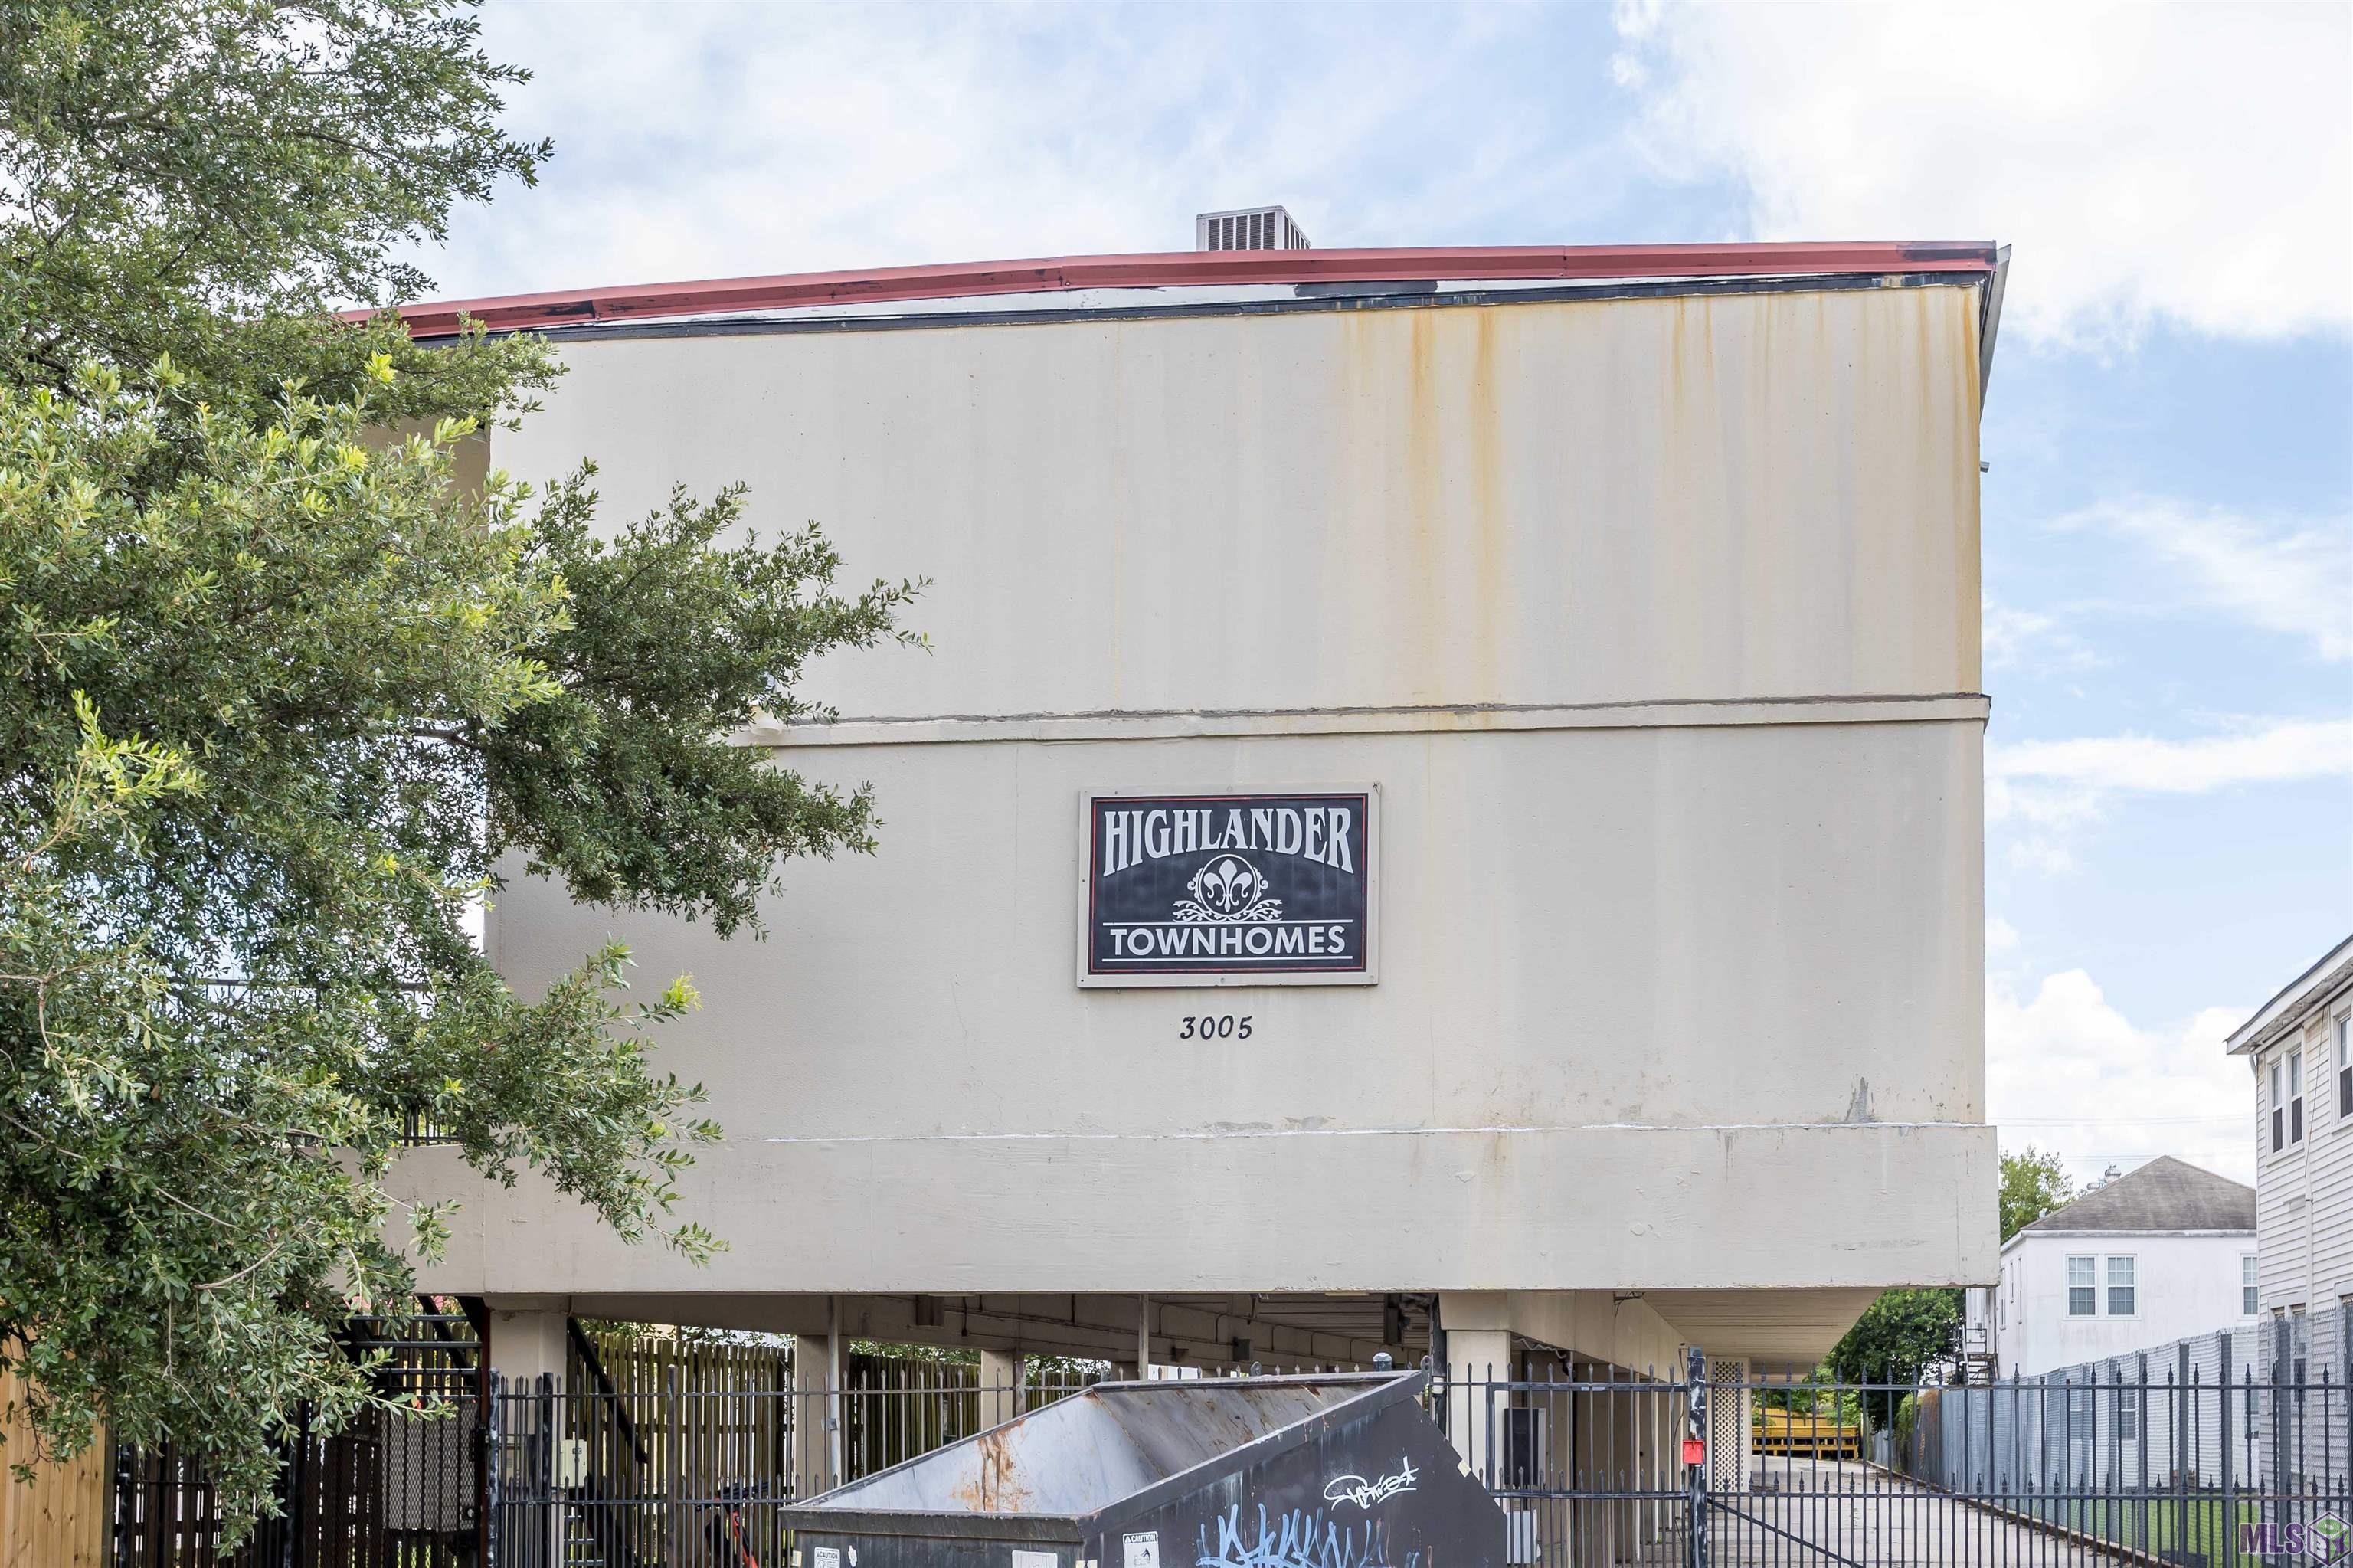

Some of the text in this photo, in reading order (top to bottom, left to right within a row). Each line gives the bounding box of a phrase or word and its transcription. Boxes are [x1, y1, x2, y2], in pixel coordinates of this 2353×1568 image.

[1103, 807, 1353, 877] HIGHLANDER
[1111, 926, 1345, 956] TOWNHOMES
[1180, 1015, 1253, 1040] 3005
[1131, 1534, 1156, 1543] CAUTION
